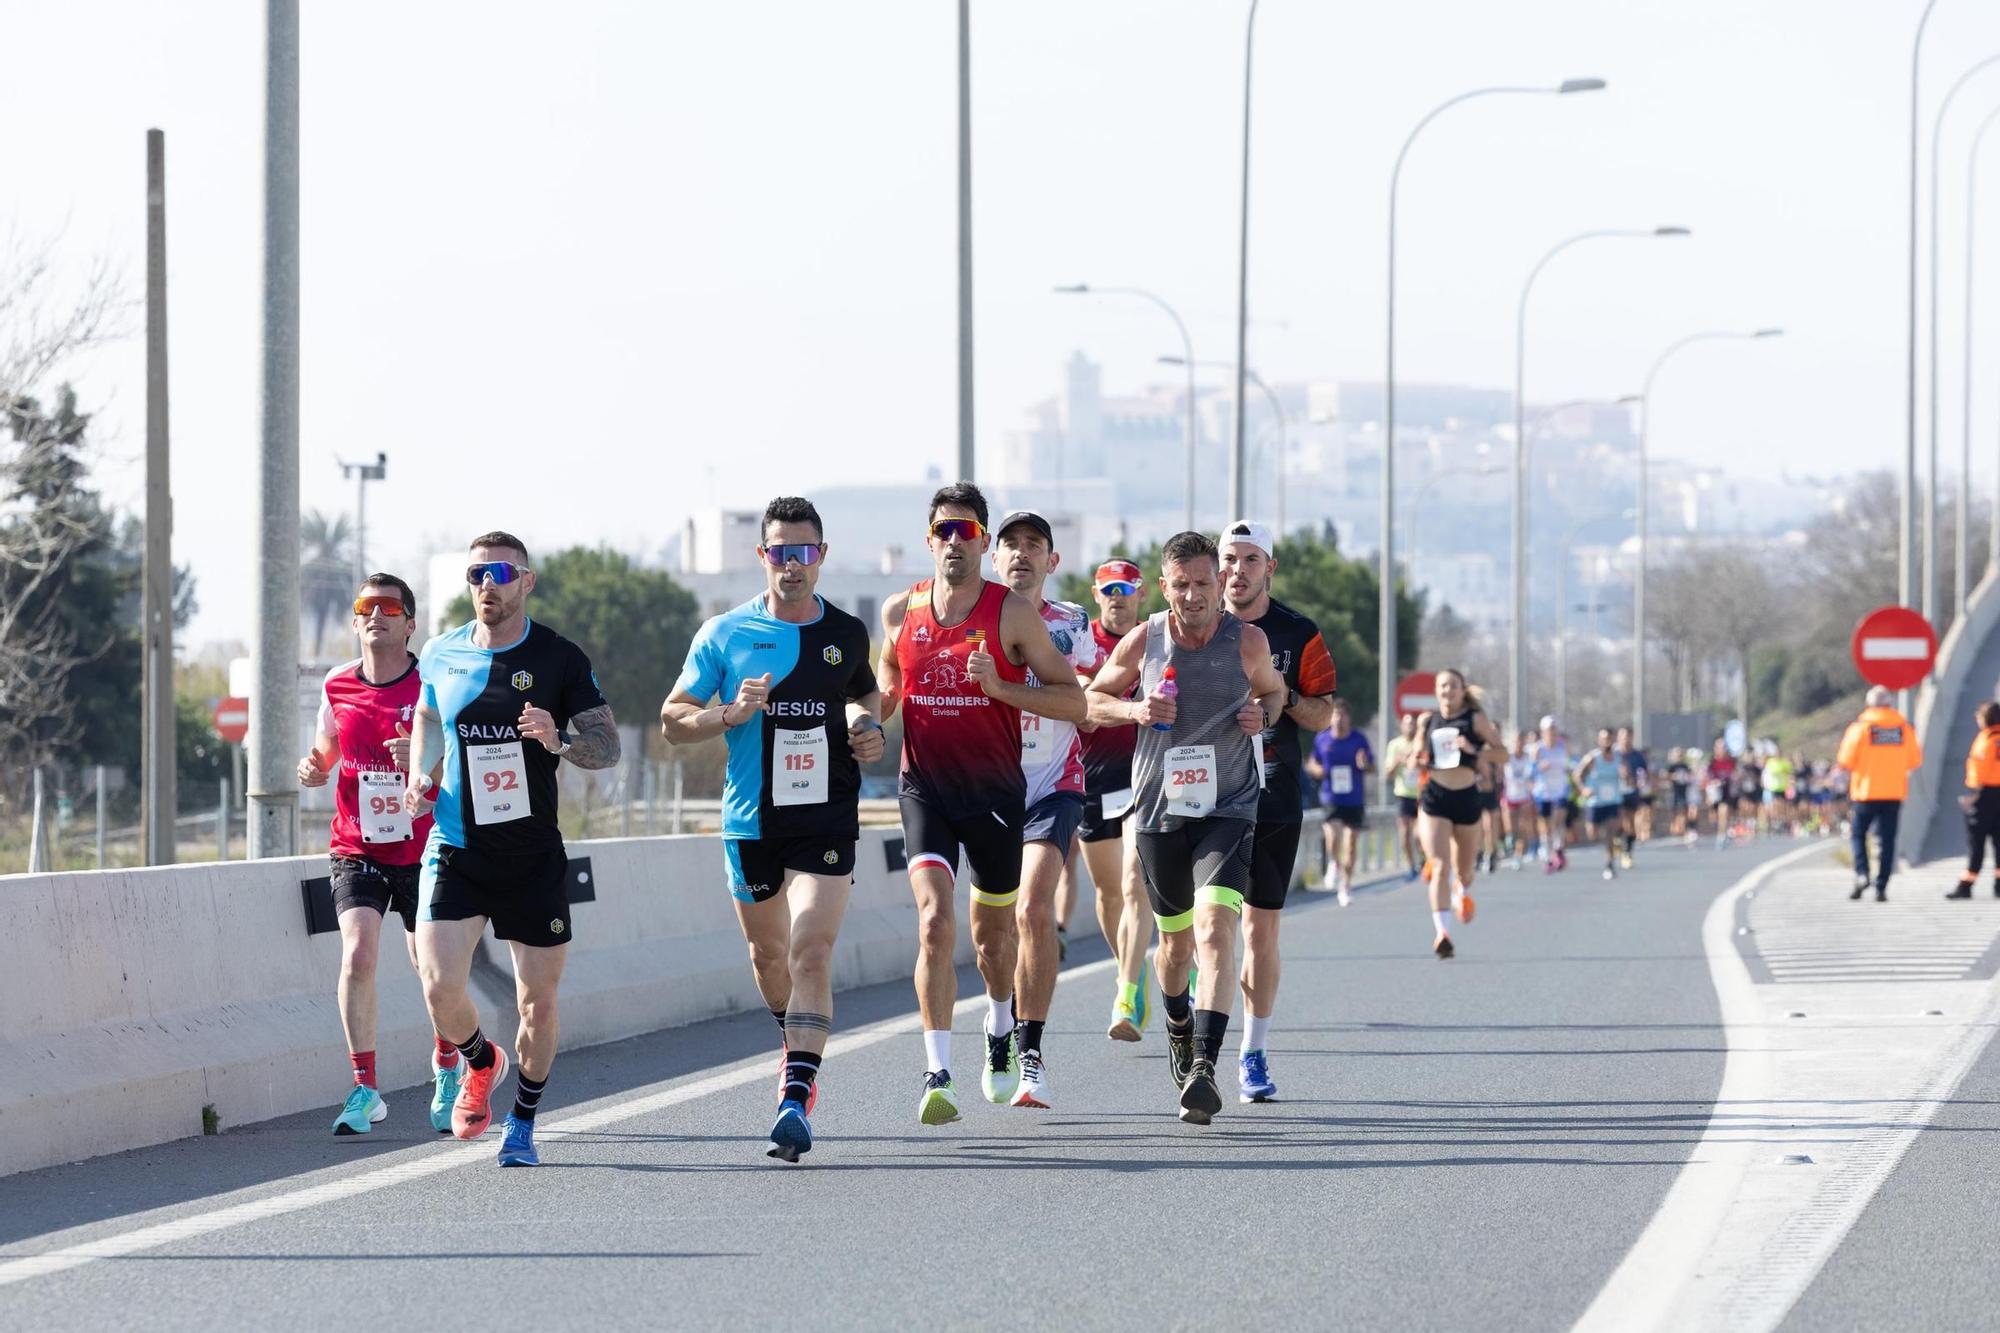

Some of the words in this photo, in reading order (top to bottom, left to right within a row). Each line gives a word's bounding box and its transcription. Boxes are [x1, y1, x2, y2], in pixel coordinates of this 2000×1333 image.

[766, 698, 826, 717] JESÚS
[909, 694, 990, 706] TRIBOMBERS
[932, 708, 961, 716] Eivissa
[458, 723, 517, 739] SALVA
[486, 747, 502, 755] 2024
[784, 753, 815, 771] 115
[483, 770, 519, 793] 92
[1171, 768, 1209, 786] 282
[369, 796, 401, 816] 95
